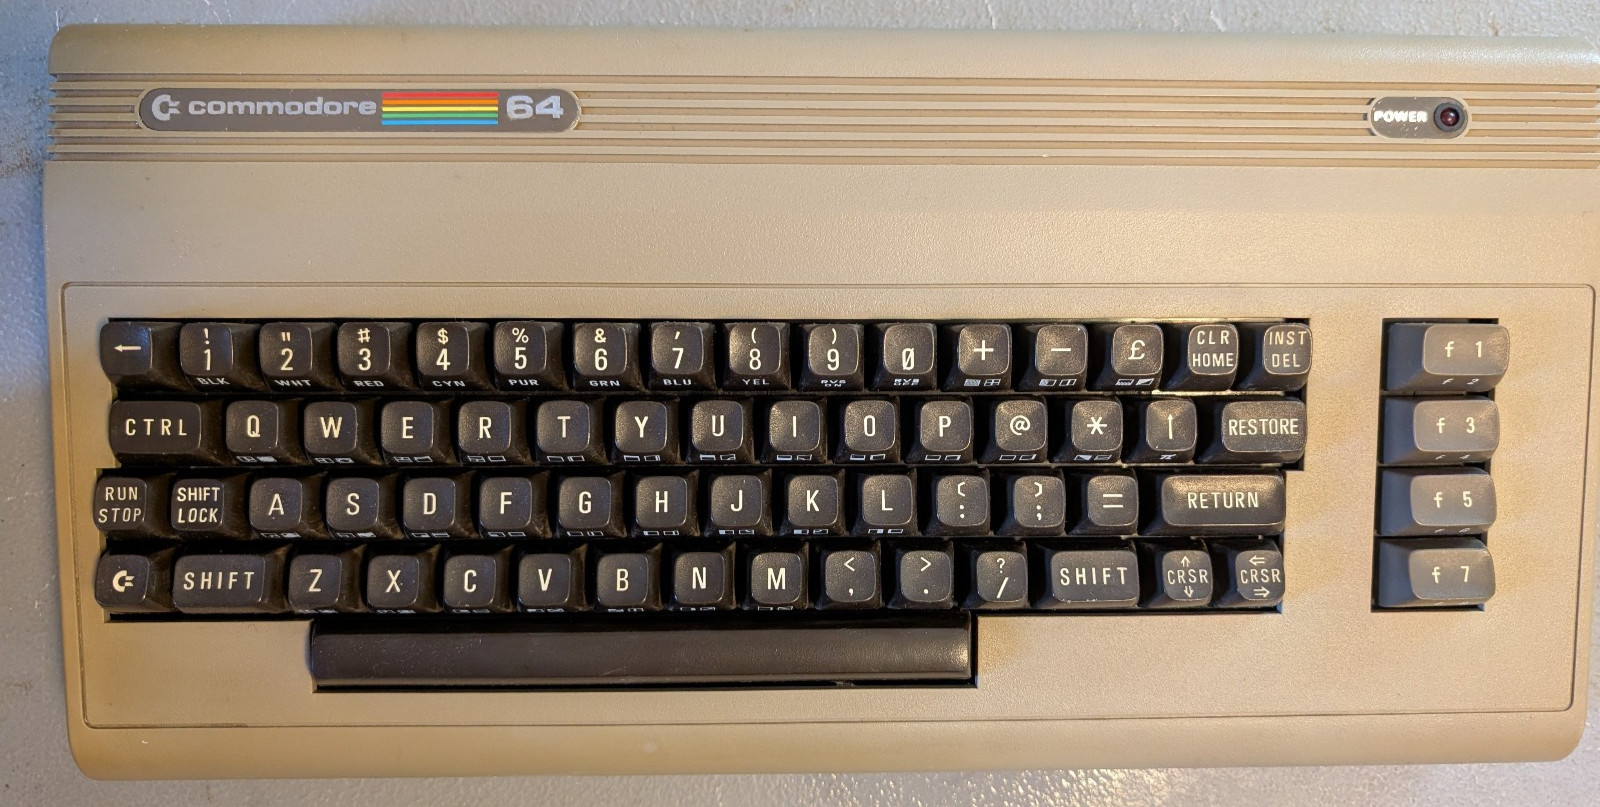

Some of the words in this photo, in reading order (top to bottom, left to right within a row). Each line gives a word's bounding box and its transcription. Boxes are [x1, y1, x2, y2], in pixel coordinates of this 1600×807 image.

[188, 95, 376, 115] commodore
[506, 95, 564, 119] 64
[1374, 110, 1427, 122] POWER
[438, 328, 448, 344] $
[512, 328, 528, 343] %
[595, 328, 606, 343] &
[1197, 331, 1229, 344] CLR
[1270, 331, 1306, 345] INST
[281, 348, 293, 370] 2
[359, 348, 371, 370] 3
[437, 349, 450, 370] 4
[515, 347, 526, 369] 5
[595, 348, 607, 370] 6
[672, 348, 683, 368] 7
[750, 349, 761, 370] 8
[827, 349, 839, 370] 9
[1128, 340, 1145, 359] £
[1192, 352, 1234, 367] HOME
[1272, 354, 1300, 367] DEL
[274, 379, 311, 387] WHT
[589, 379, 620, 387] GRN
[126, 419, 186, 435] CTRL
[247, 415, 260, 437] Q
[320, 417, 342, 438] W
[403, 417, 413, 438] E
[480, 417, 491, 438] R
[558, 416, 570, 437] T
[635, 416, 648, 437] Y
[712, 415, 724, 436] U
[864, 415, 875, 436] O
[939, 416, 951, 437] P
[1010, 415, 1030, 435] @
[1229, 419, 1298, 435] RESTORE
[106, 487, 137, 500] RUN
[177, 487, 220, 501] SHIFT
[347, 493, 359, 515] S
[424, 493, 436, 514] D
[501, 492, 512, 514] F
[579, 491, 591, 513] G
[656, 491, 667, 512] H
[731, 490, 742, 511] J
[807, 490, 819, 511] K
[882, 490, 893, 510] L
[1187, 491, 1259, 509] RETURN
[269, 494, 284, 515] A
[98, 508, 141, 523] STOP
[178, 508, 218, 523] LOCK
[996, 557, 1006, 574] ?
[1060, 567, 1127, 585] SHIFT
[1241, 569, 1280, 583] CRSR
[184, 572, 254, 590] SHIFT
[309, 569, 322, 591] Z
[386, 570, 400, 592] X
[464, 570, 476, 592] C
[538, 569, 552, 591] V
[617, 569, 628, 591] B
[693, 567, 706, 589] N
[768, 568, 785, 589] M
[1168, 569, 1208, 584] CRSR
